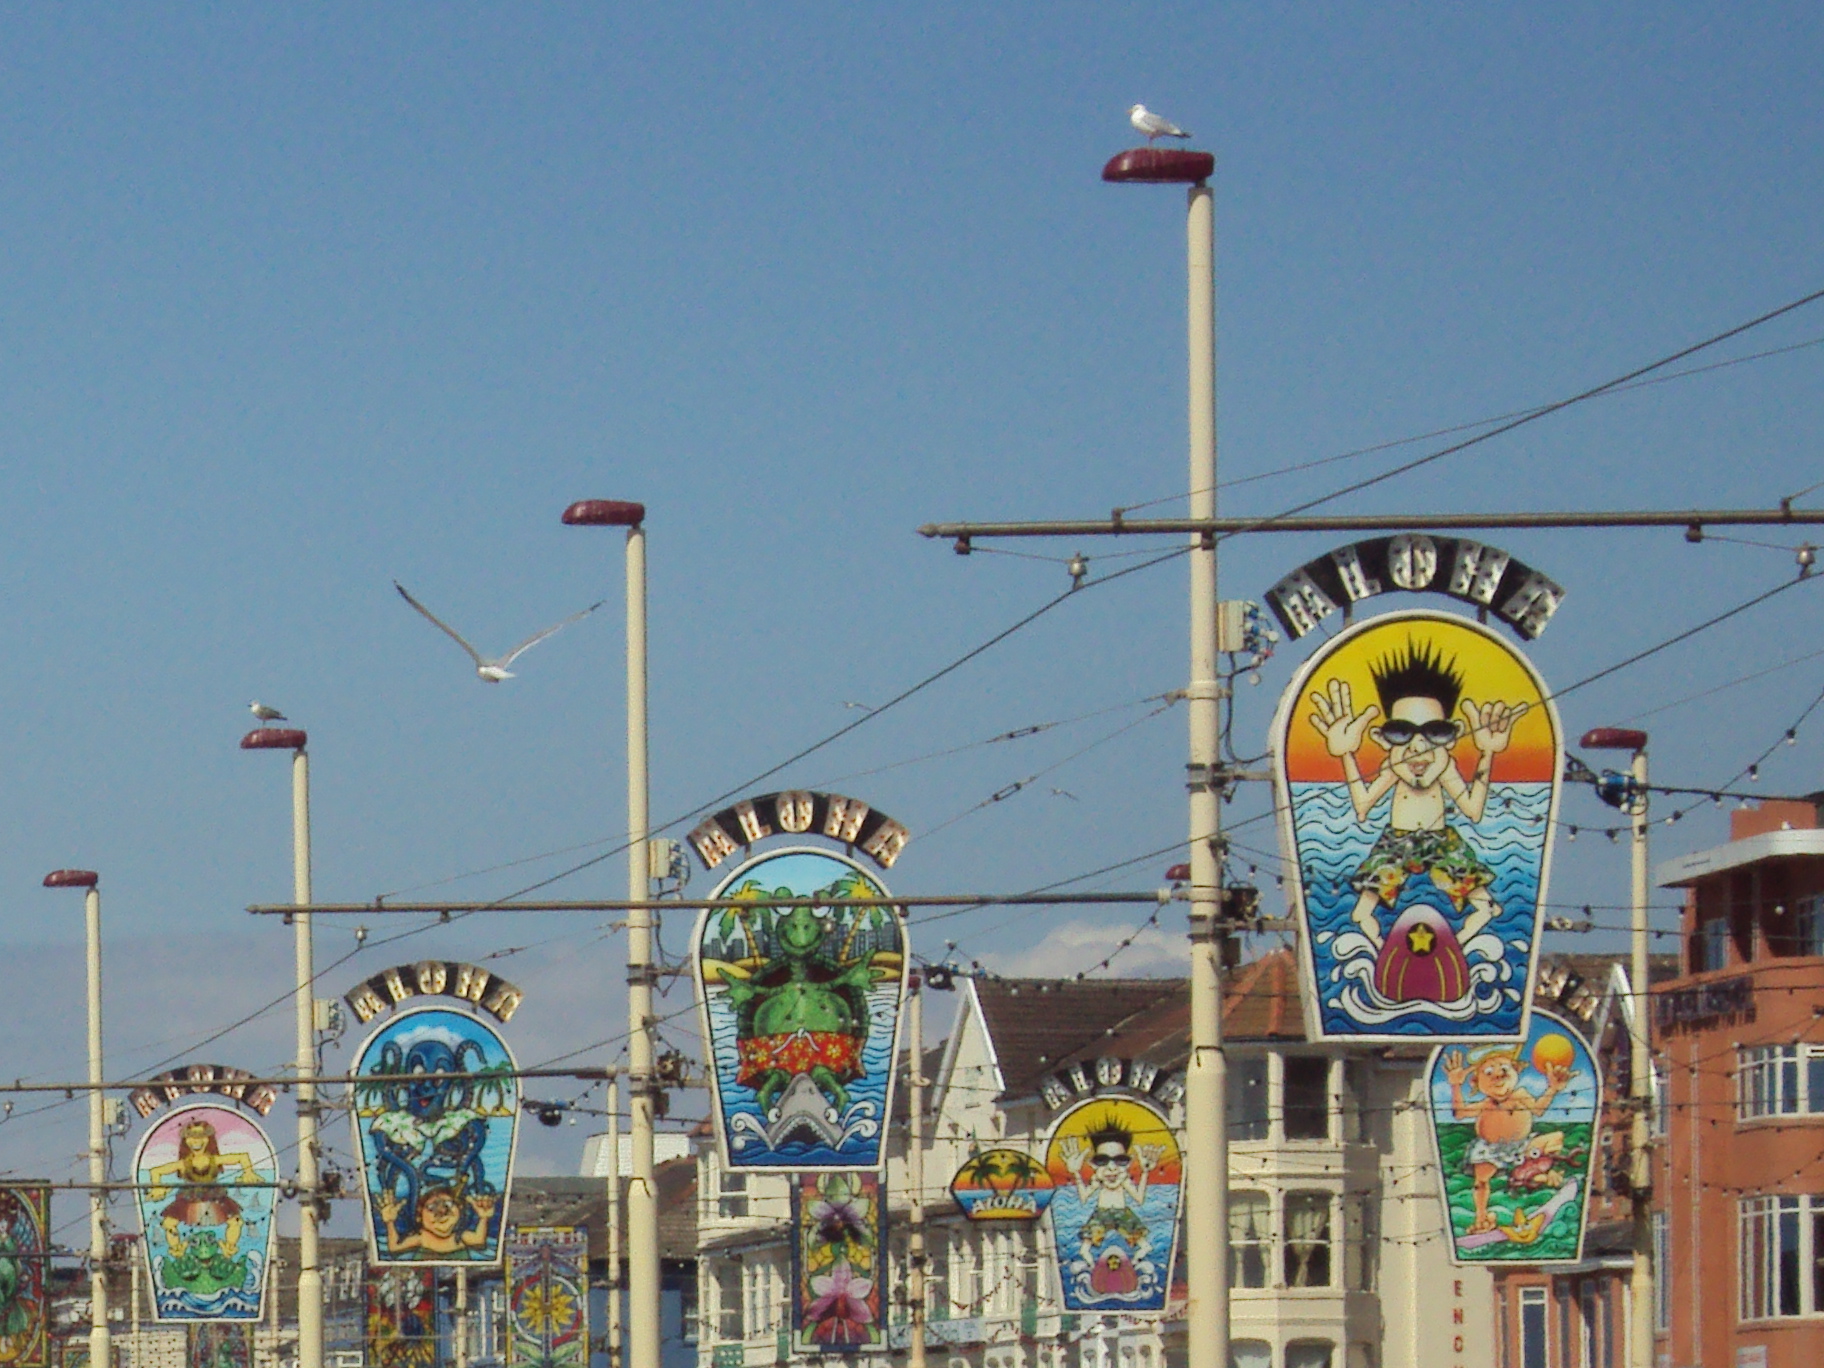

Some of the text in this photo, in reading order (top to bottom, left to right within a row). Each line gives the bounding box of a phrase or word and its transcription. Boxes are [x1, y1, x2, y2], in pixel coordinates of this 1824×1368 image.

[1272, 533, 1566, 640] ALOHA
[690, 790, 909, 869] ALOHA
[349, 960, 524, 1023] ALOHA
[131, 1064, 278, 1118] ALOHA
[1042, 1057, 1187, 1110] ALOHA
[972, 1195, 1036, 1215] ALOHA
